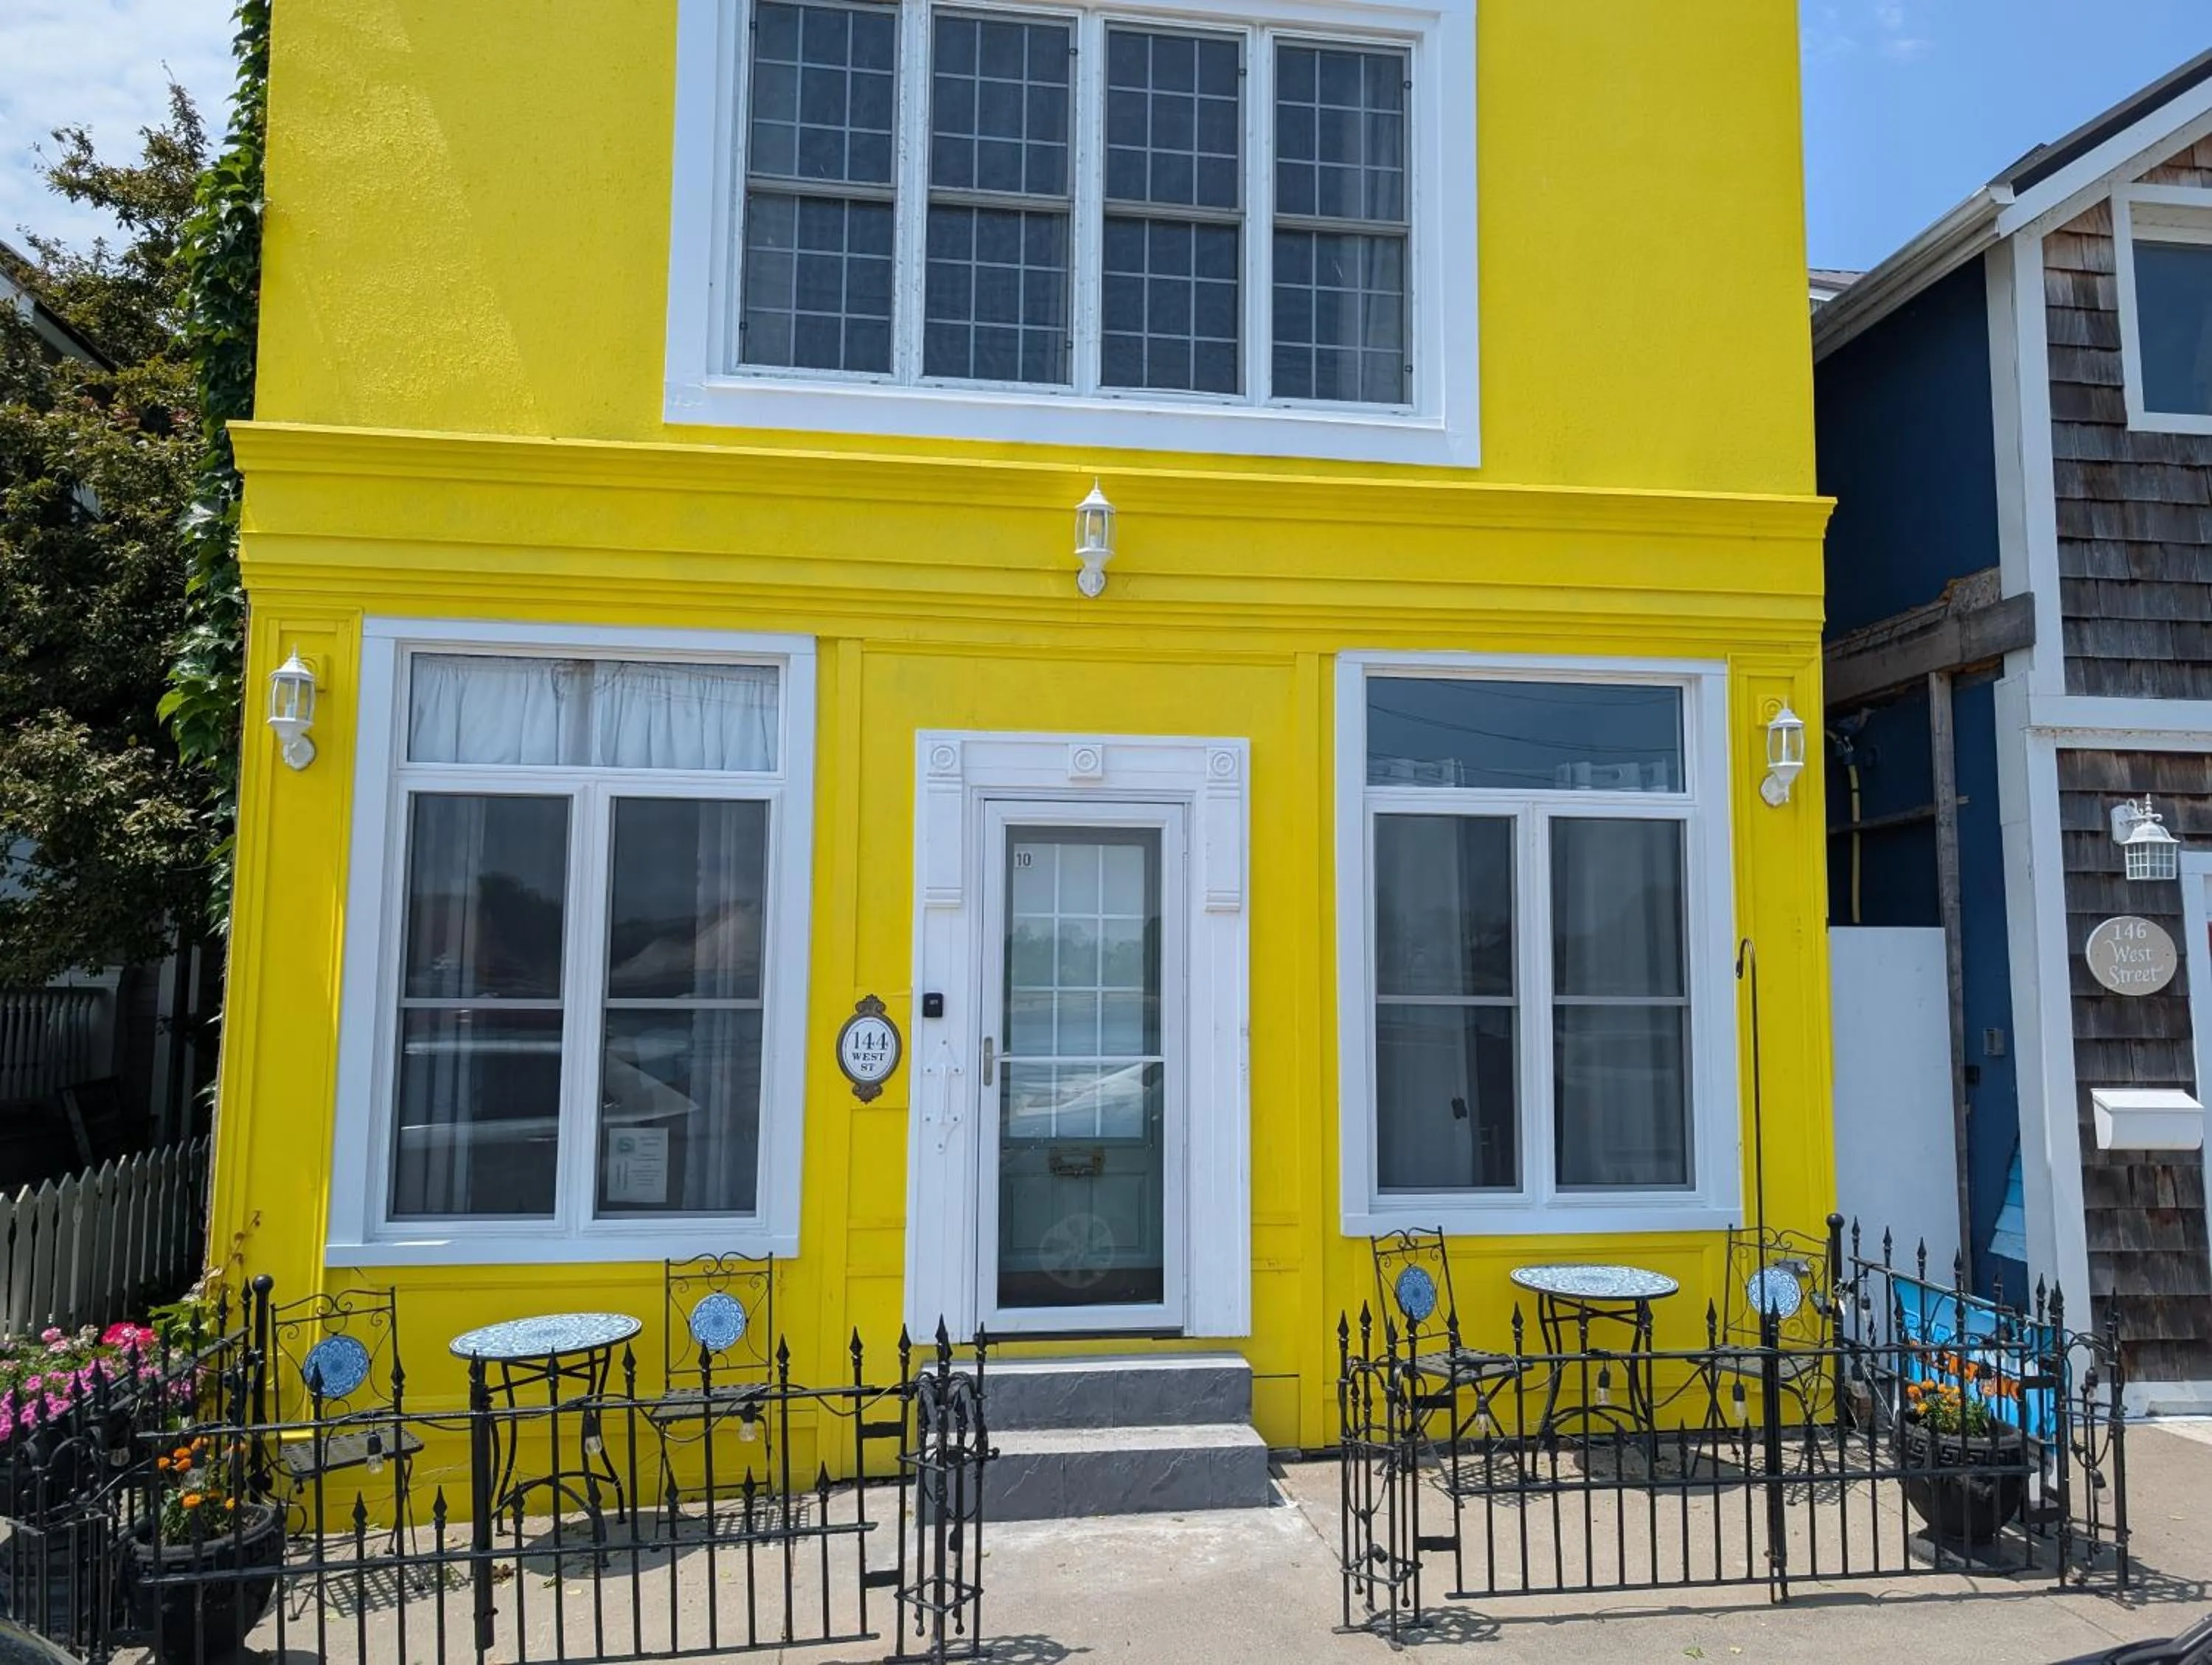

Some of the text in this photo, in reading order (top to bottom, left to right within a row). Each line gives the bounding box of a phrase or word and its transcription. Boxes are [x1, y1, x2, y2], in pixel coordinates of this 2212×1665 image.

[1016, 852, 1032, 867] 10
[2110, 922, 2146, 940] 146
[2104, 939, 2153, 963] West
[2108, 964, 2164, 987] Street
[852, 1032, 888, 1051] 144
[852, 1052, 886, 1061] WEST
[860, 1063, 875, 1071] ST
